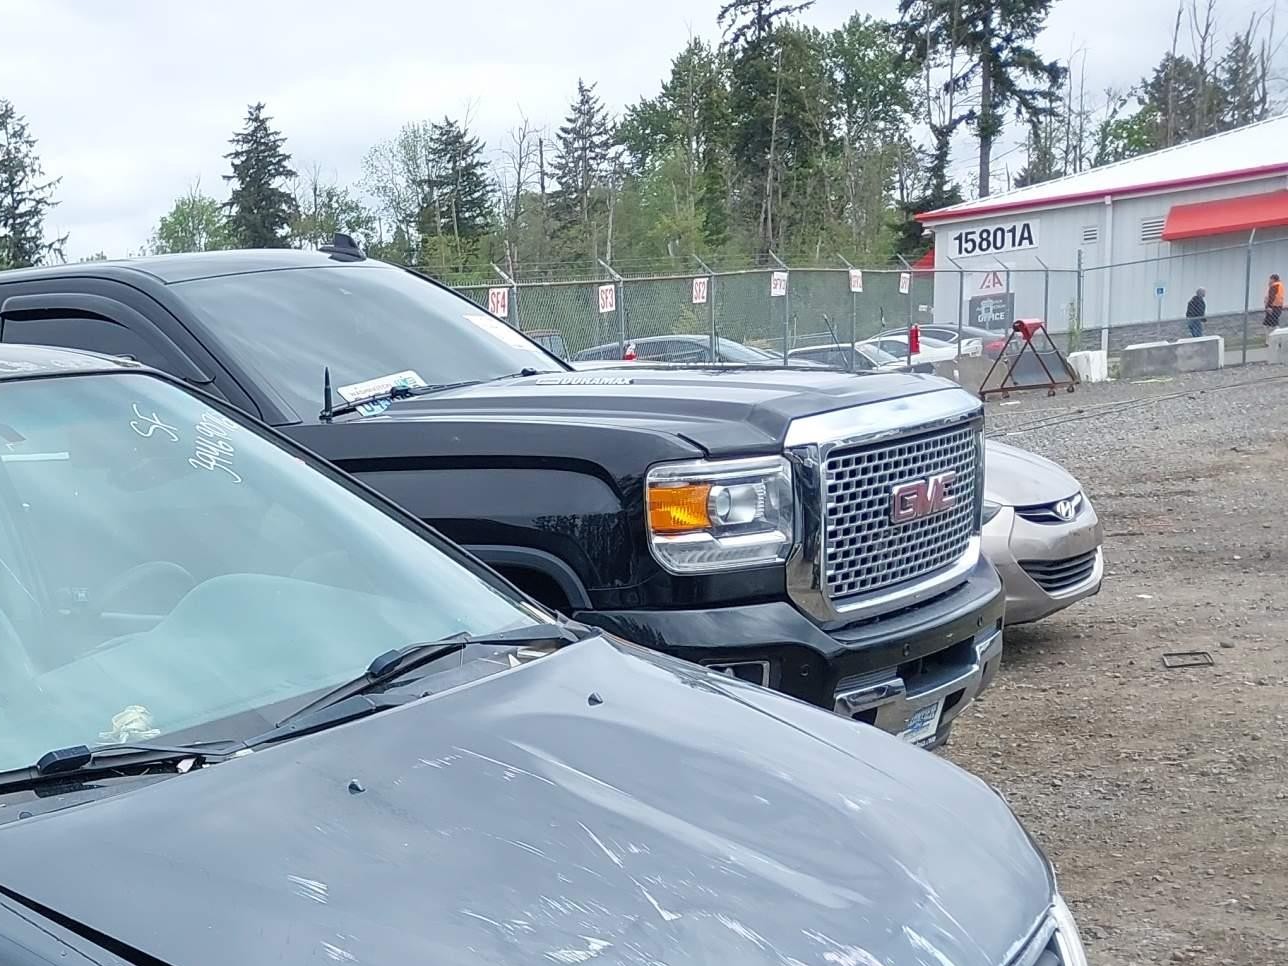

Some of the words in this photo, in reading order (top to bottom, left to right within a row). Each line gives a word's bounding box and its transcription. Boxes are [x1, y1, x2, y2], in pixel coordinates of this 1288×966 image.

[953, 223, 1034, 255] 15801A
[491, 291, 506, 314] SF4
[600, 288, 614, 309] SF3
[561, 377, 631, 385] DURAMAX
[130, 403, 179, 441] SF
